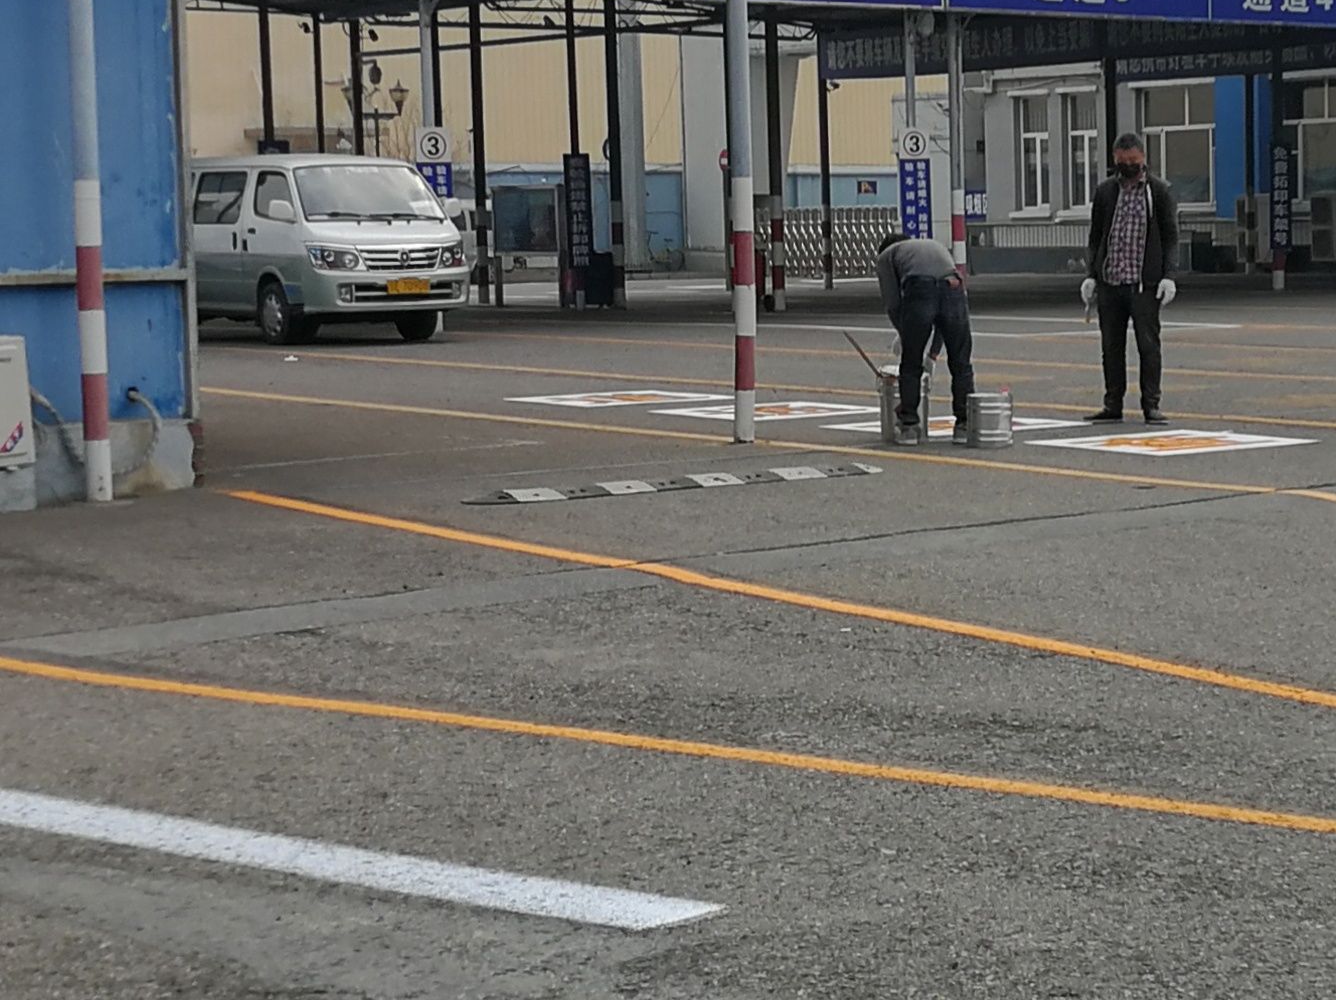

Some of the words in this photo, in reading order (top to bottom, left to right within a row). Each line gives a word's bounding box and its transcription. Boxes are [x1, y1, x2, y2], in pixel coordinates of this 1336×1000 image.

[1272, 146, 1289, 246] 免费拓印车架号
